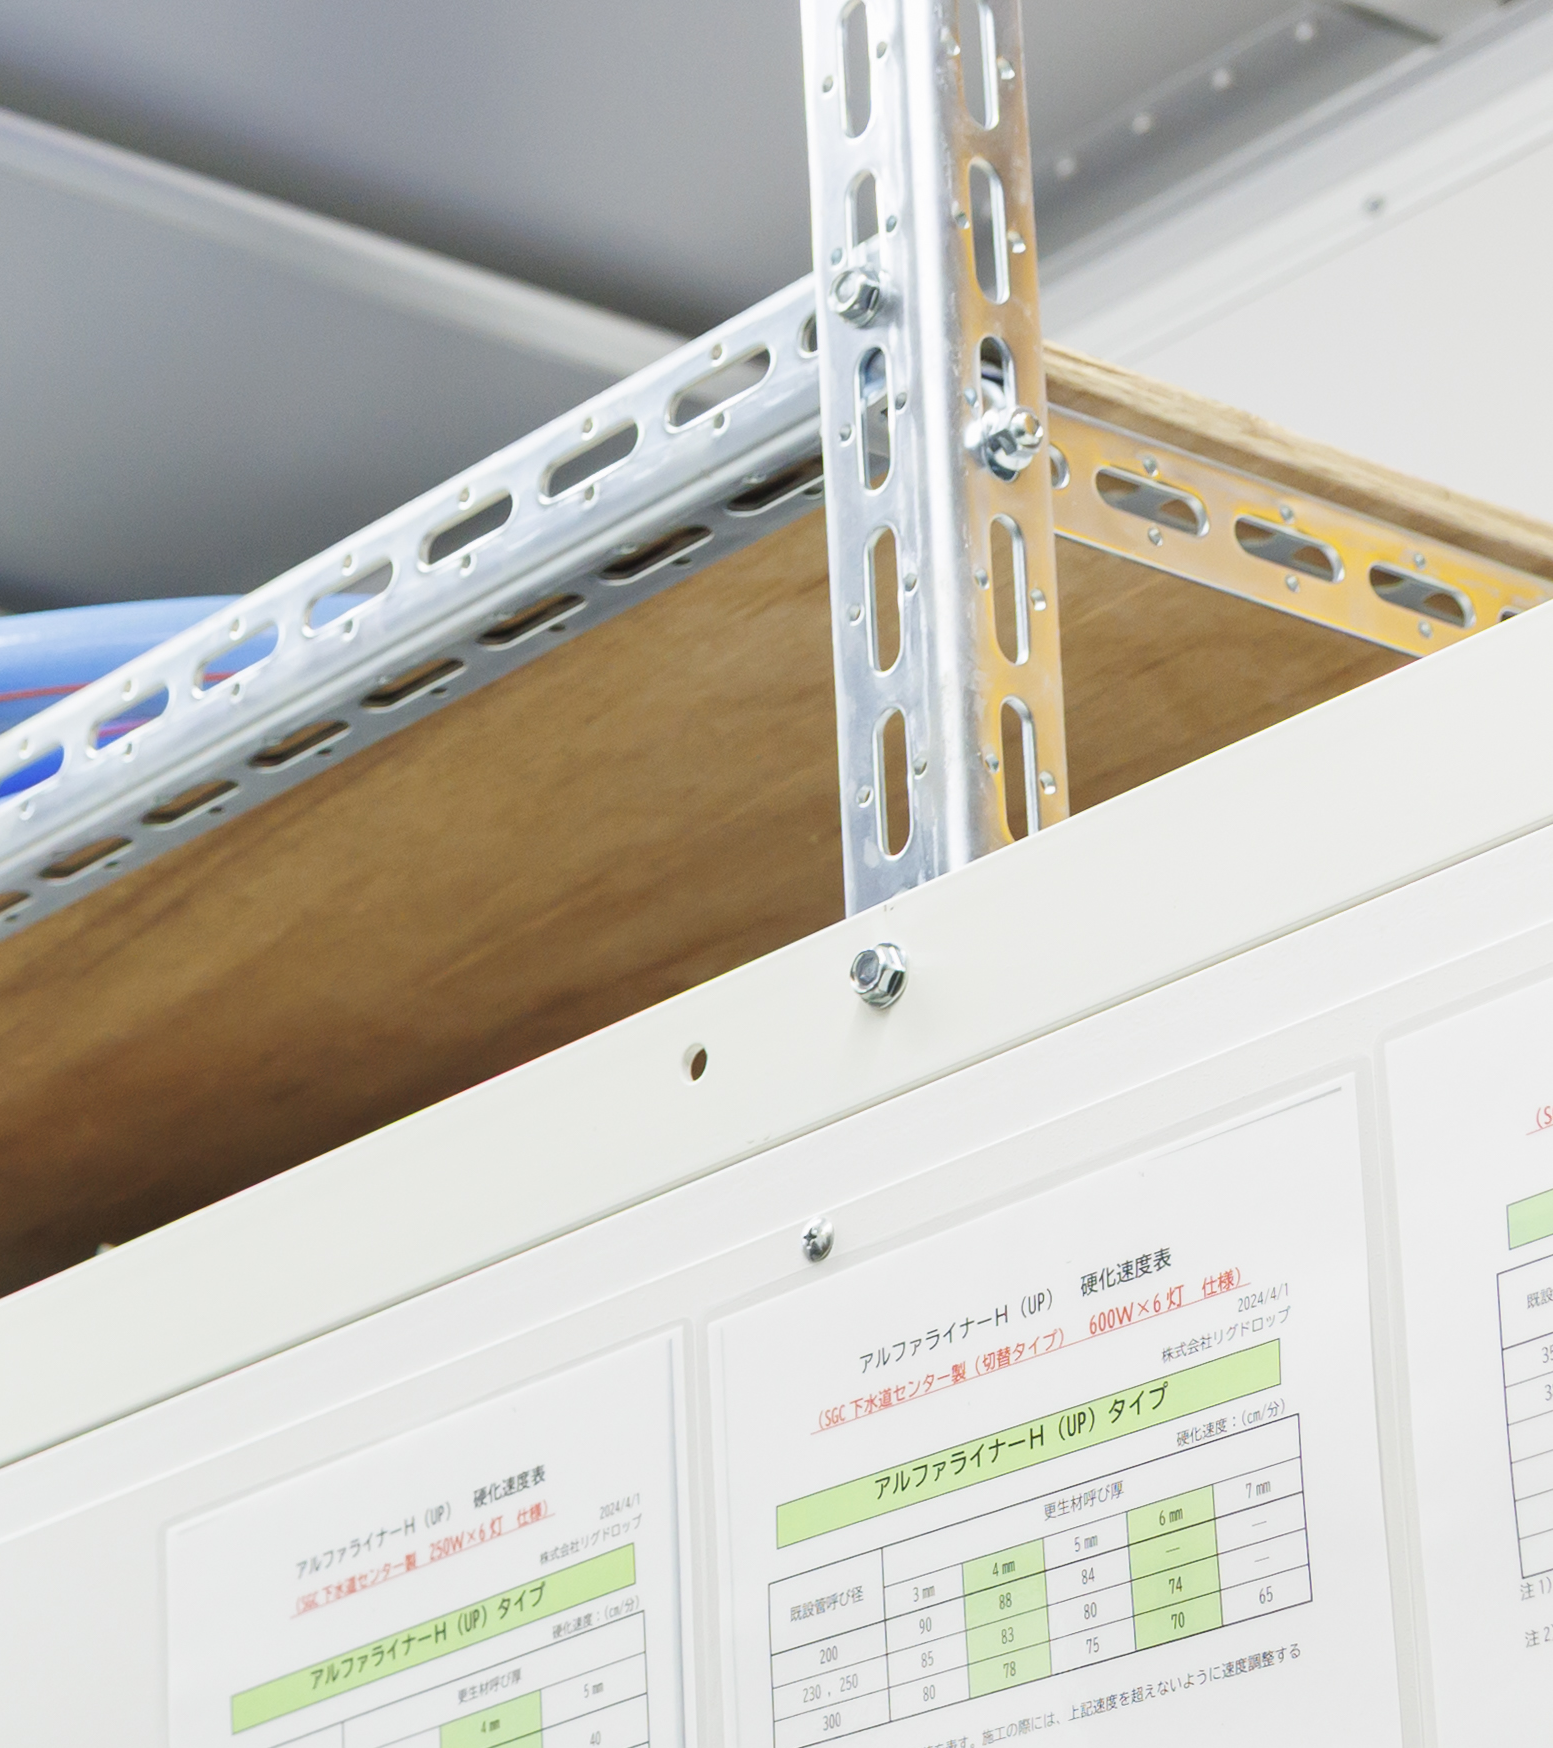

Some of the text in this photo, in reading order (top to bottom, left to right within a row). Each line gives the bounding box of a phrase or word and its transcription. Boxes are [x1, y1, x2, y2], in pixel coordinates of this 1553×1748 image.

[1079, 1246, 1172, 1297] 硬化速度表
[1237, 1281, 1289, 1313] 2024/4/1
[1161, 1304, 1291, 1364] 株式会社リグドロップ
[472, 1464, 546, 1509] 硬化速度表
[598, 1491, 641, 1521] 2024/4/1
[1043, 1479, 1125, 1522] 更生材呼び厚
[538, 1512, 643, 1566] 株式会社リグドロップ
[789, 1584, 865, 1623] 既設管呼び径
[818, 1566, 1095, 1665] 200 90 88 84
[920, 1649, 935, 1669] 85
[1000, 1625, 1015, 1645] 83
[1082, 1600, 1098, 1621] 80
[1167, 1575, 1183, 1595] 74
[822, 1584, 1274, 1732] 300 80 78 75 70 65
[457, 1667, 522, 1705] 更生材呼び厚
[588, 1729, 602, 1747] 40
